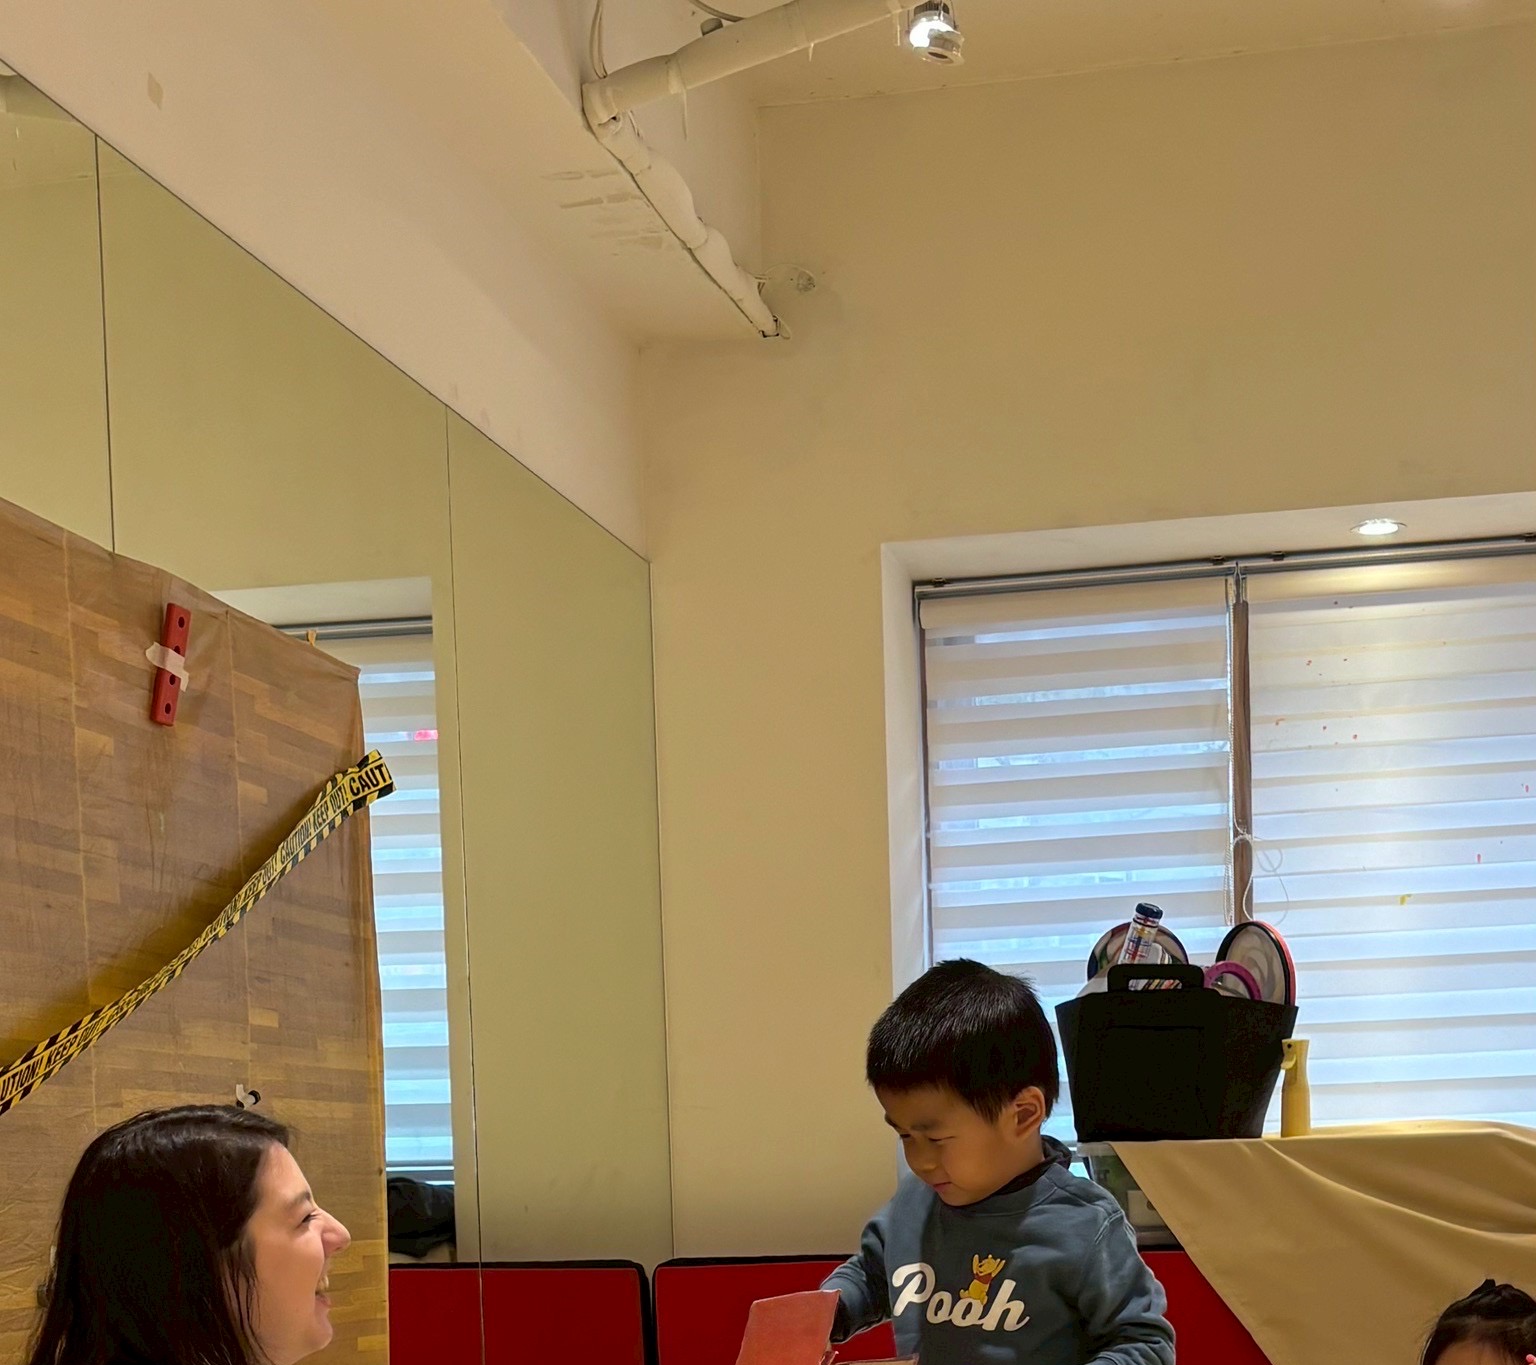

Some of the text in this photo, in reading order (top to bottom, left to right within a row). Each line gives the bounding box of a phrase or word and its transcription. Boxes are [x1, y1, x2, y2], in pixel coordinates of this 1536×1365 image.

[312, 802, 330, 831] KEEP
[330, 783, 349, 811] OUT!
[46, 1034, 79, 1068] KEEP
[892, 1262, 1030, 1331] Pooh
